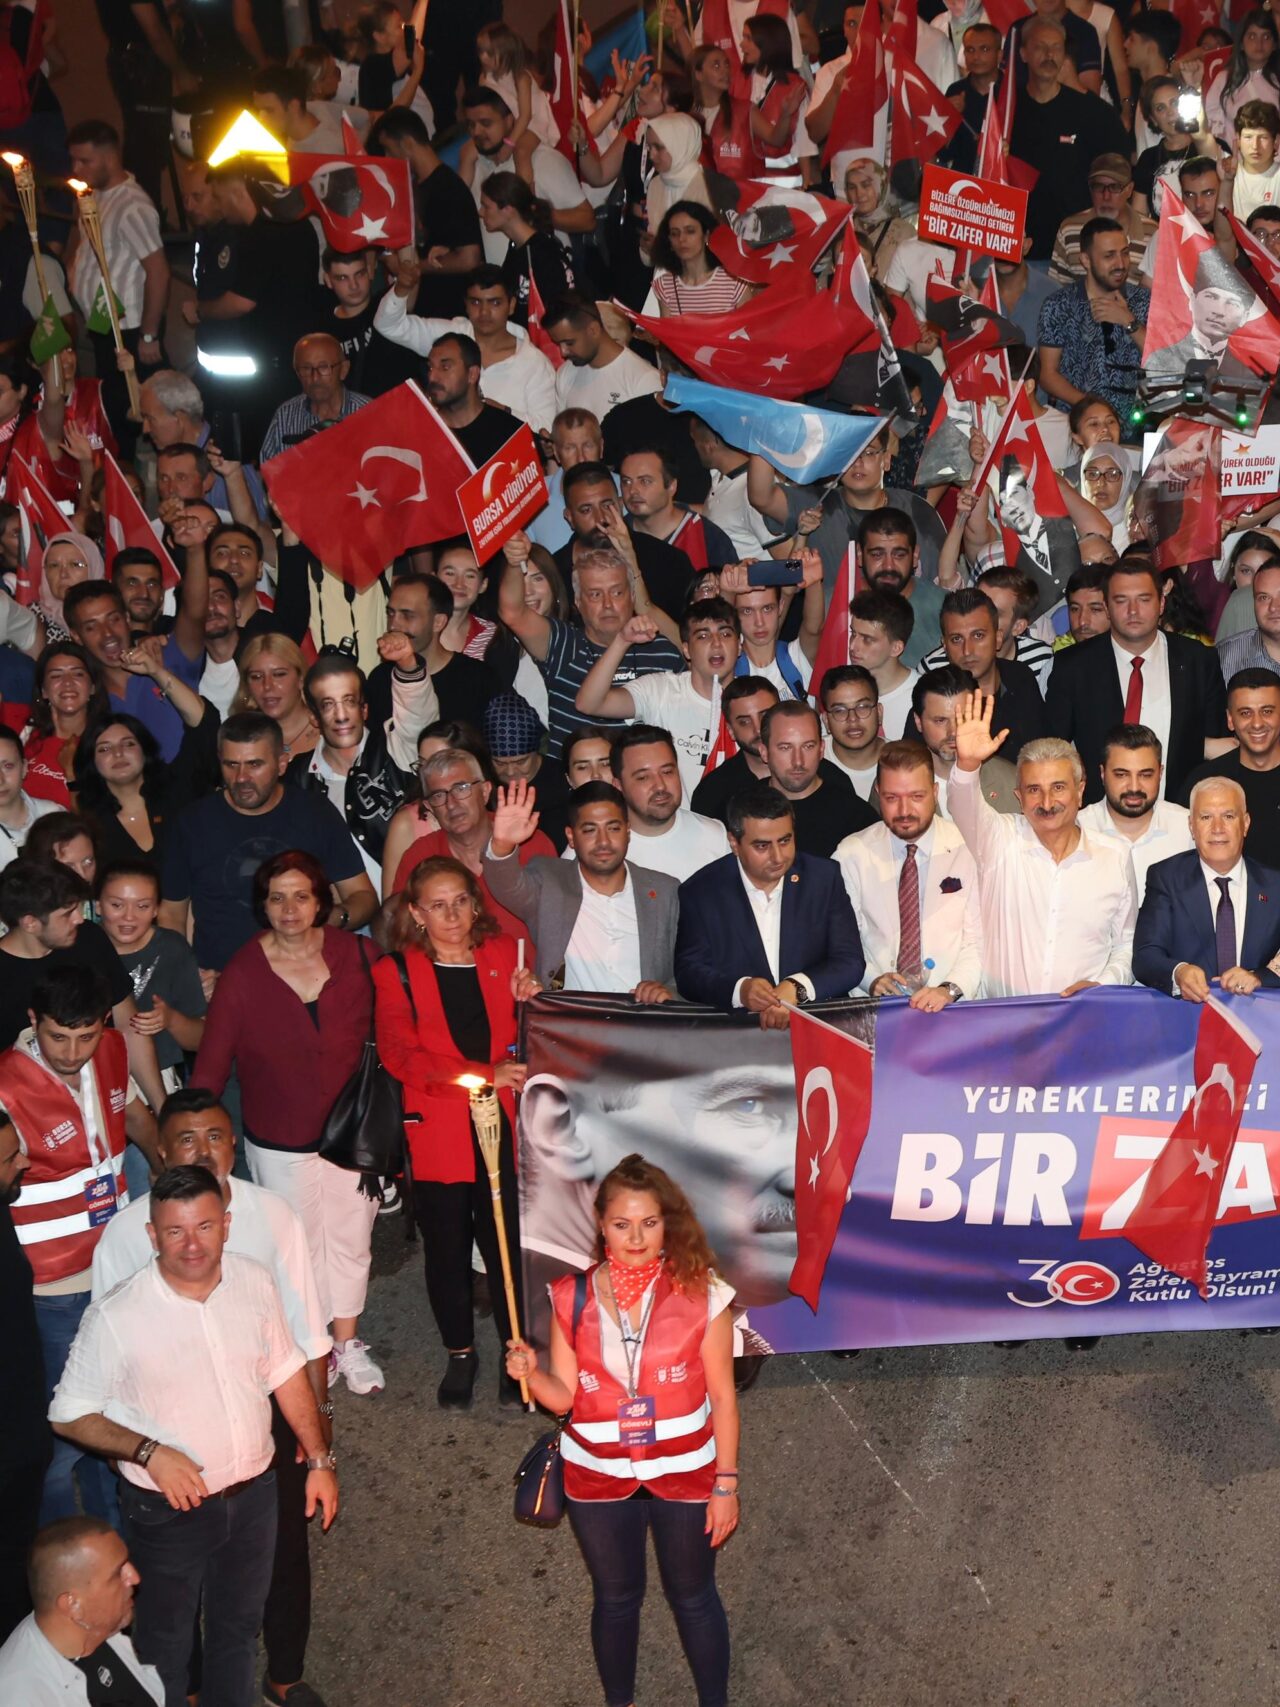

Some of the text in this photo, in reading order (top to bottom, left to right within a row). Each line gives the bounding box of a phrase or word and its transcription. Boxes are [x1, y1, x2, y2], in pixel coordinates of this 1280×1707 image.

[929, 201, 1015, 234] BAĞIMSIZLIĞIMIZI GETİREN
[931, 189, 1016, 222] BİZLERE ÖZGÜRLÜĞÜMÜZÜ
[949, 221, 983, 247] ZAFER
[986, 231, 1018, 254] VAR!”
[1245, 455, 1275, 467] OLDUĞU
[472, 460, 540, 537] BURSA YÜRÜYOR
[890, 1132, 1078, 1227] BİR
[1127, 1273, 1192, 1291] Zafer
[1128, 1281, 1276, 1303] Kutlu Olsun!
